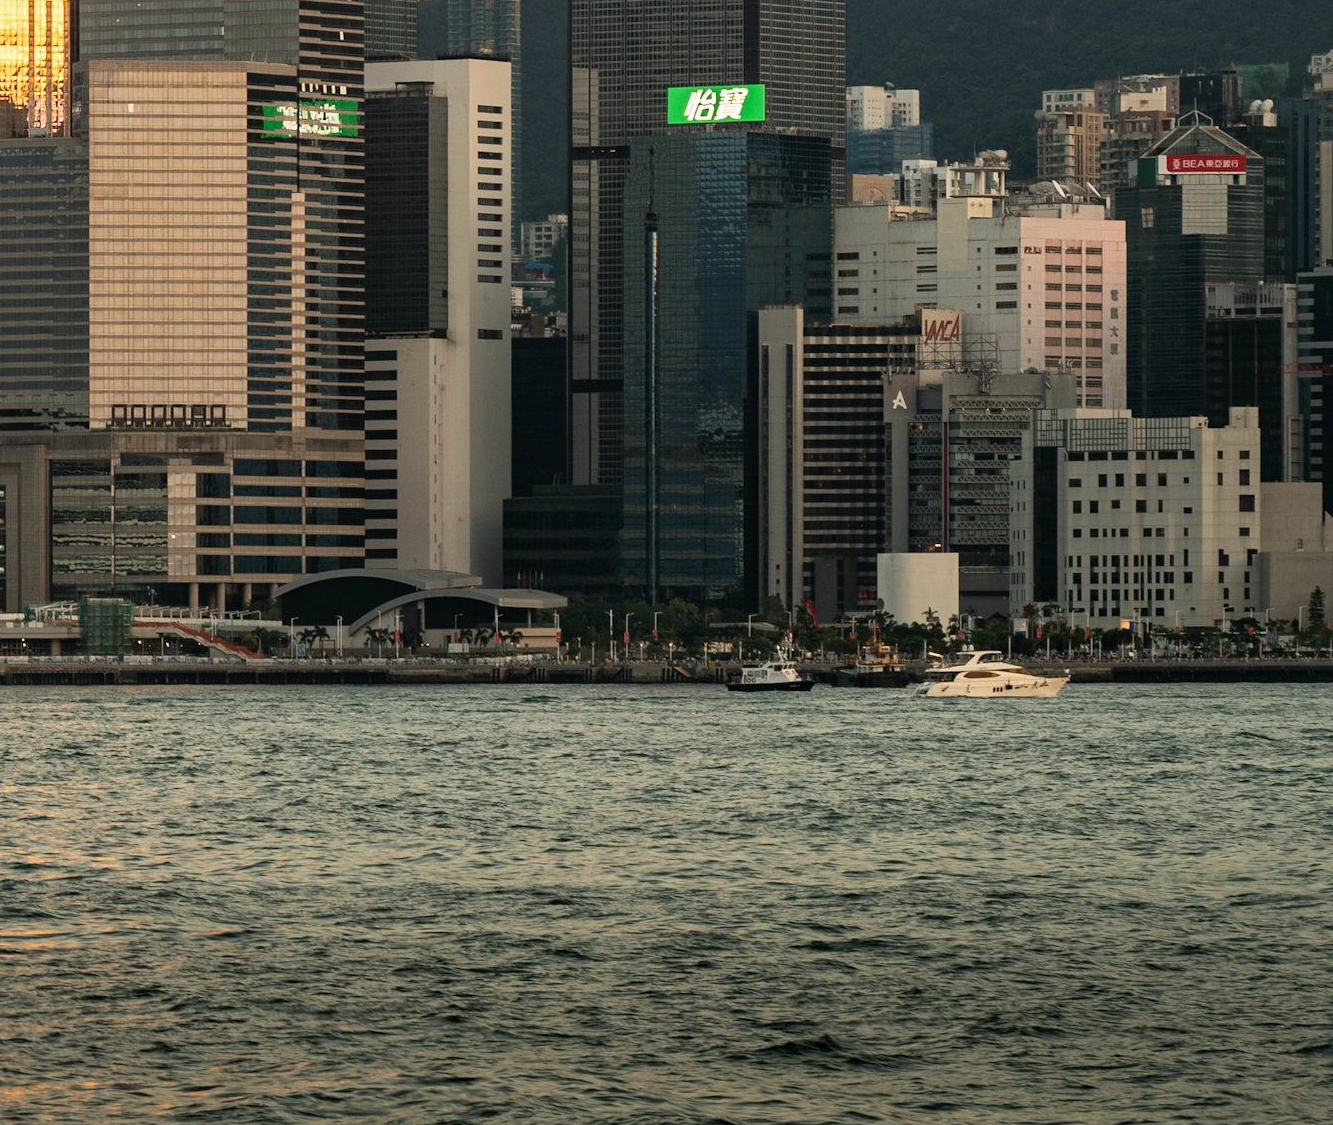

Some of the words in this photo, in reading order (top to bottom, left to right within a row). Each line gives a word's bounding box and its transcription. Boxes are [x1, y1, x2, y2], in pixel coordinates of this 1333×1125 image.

[683, 87, 749, 121] 怡寶
[1182, 159, 1206, 168] BEA
[1206, 159, 1239, 168] 東亞銀行
[925, 313, 960, 347] YMCA
